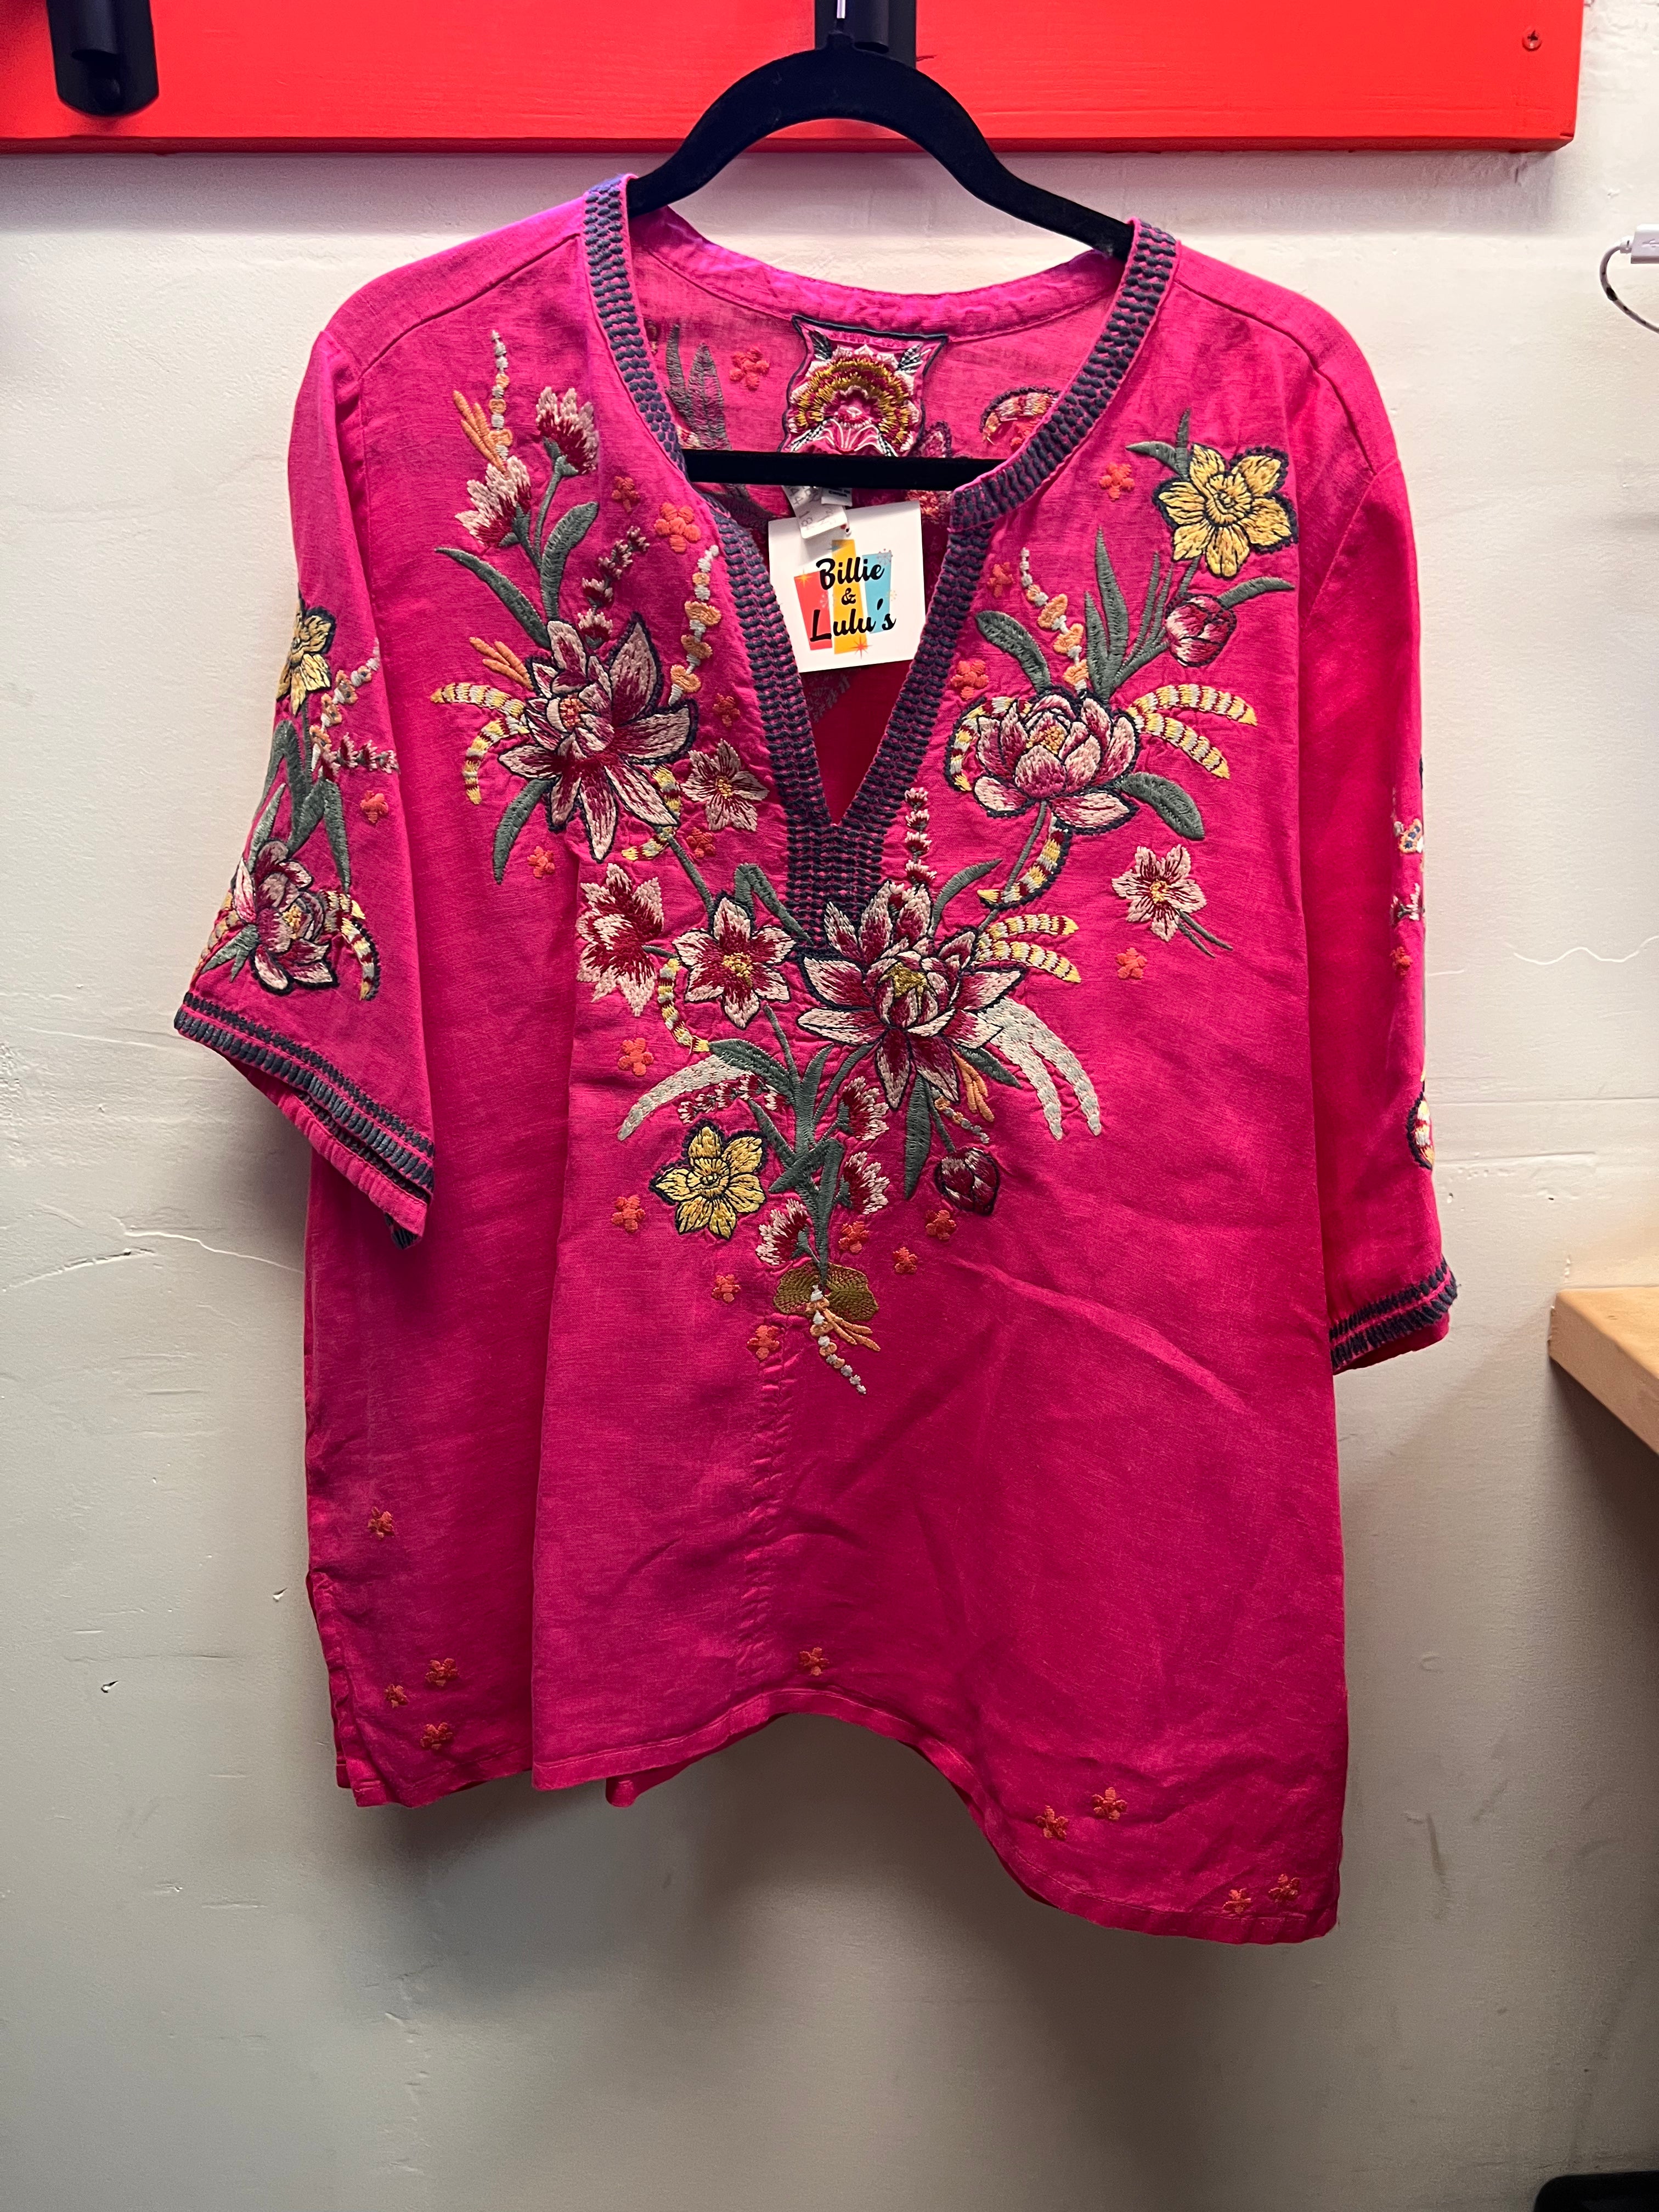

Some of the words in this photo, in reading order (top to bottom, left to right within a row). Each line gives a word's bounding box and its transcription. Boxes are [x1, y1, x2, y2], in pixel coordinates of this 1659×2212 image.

[816, 556, 885, 591] Billie
[841, 587, 856, 606] &
[810, 598, 897, 642] Lulu's
